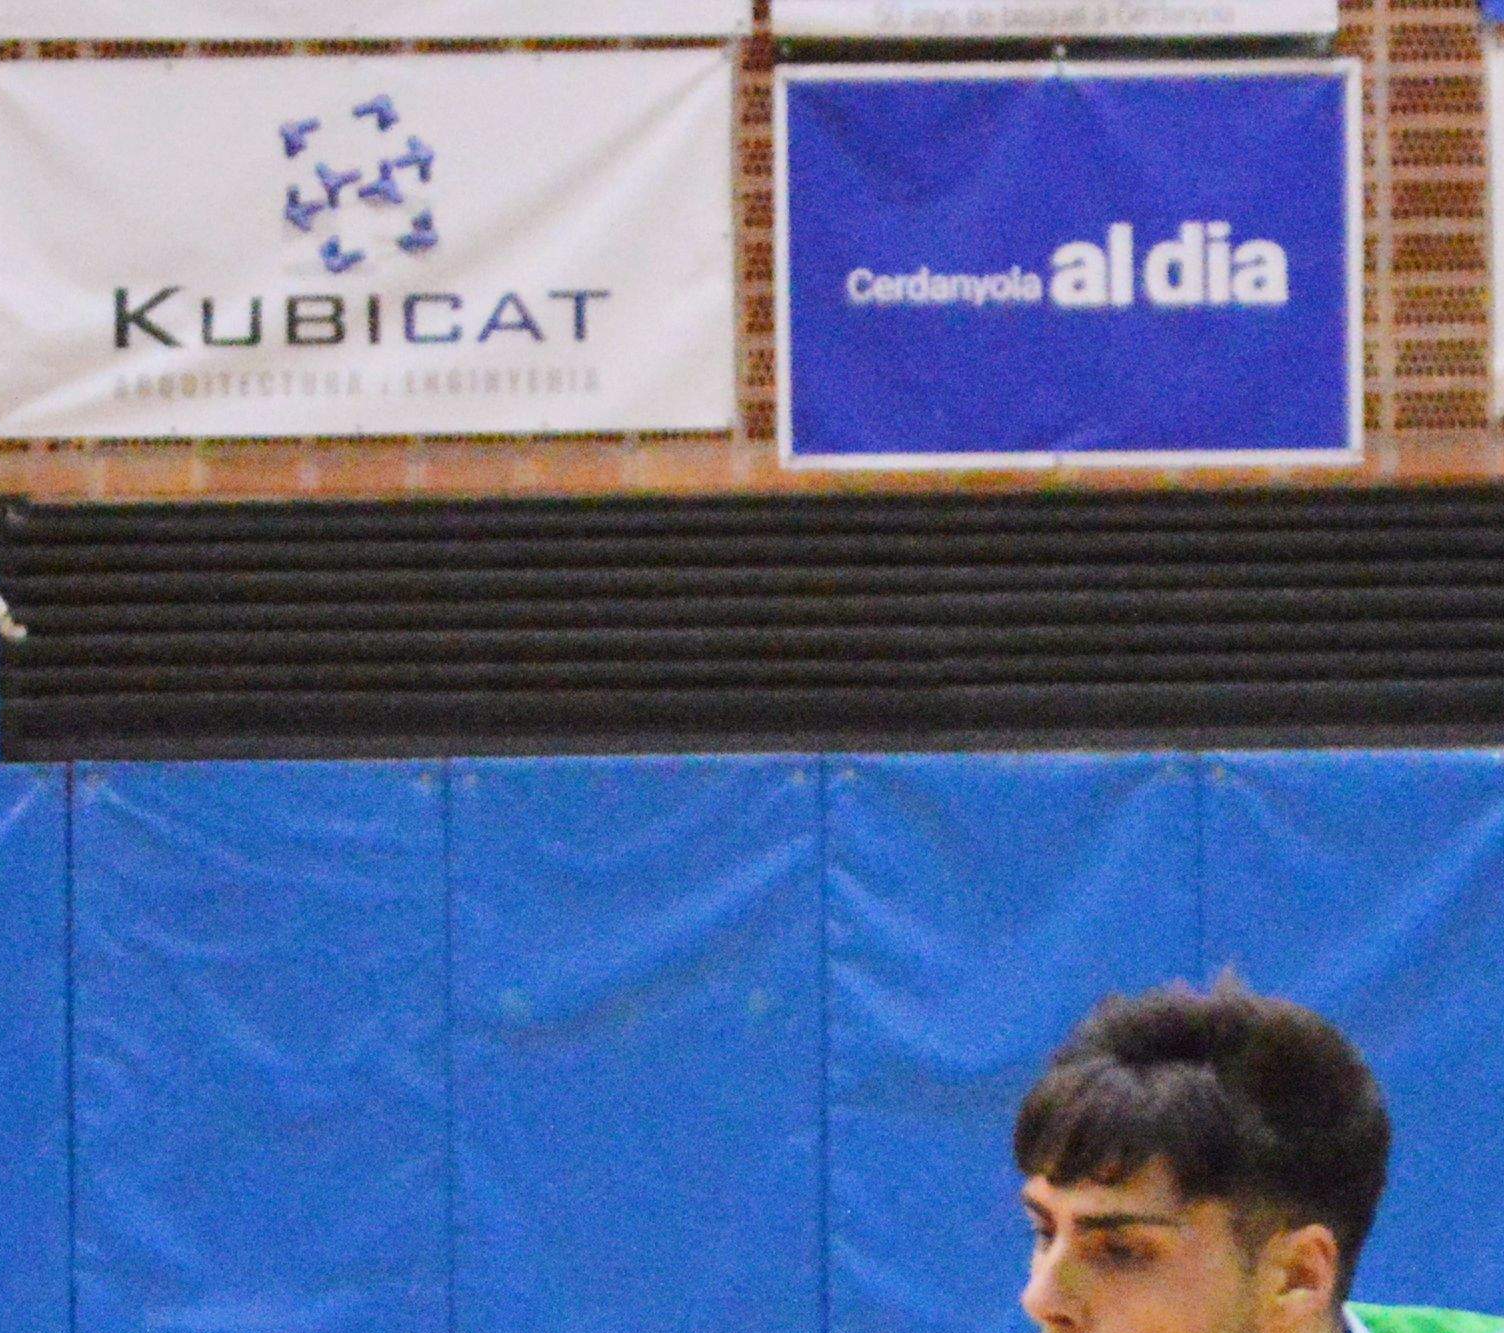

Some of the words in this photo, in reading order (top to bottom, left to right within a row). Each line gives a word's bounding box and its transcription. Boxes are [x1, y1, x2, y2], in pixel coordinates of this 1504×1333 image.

[847, 267, 1042, 306] Cerdanyola
[1049, 222, 1133, 307] al
[1143, 221, 1289, 306] dia
[112, 286, 610, 350] KUBICAT
